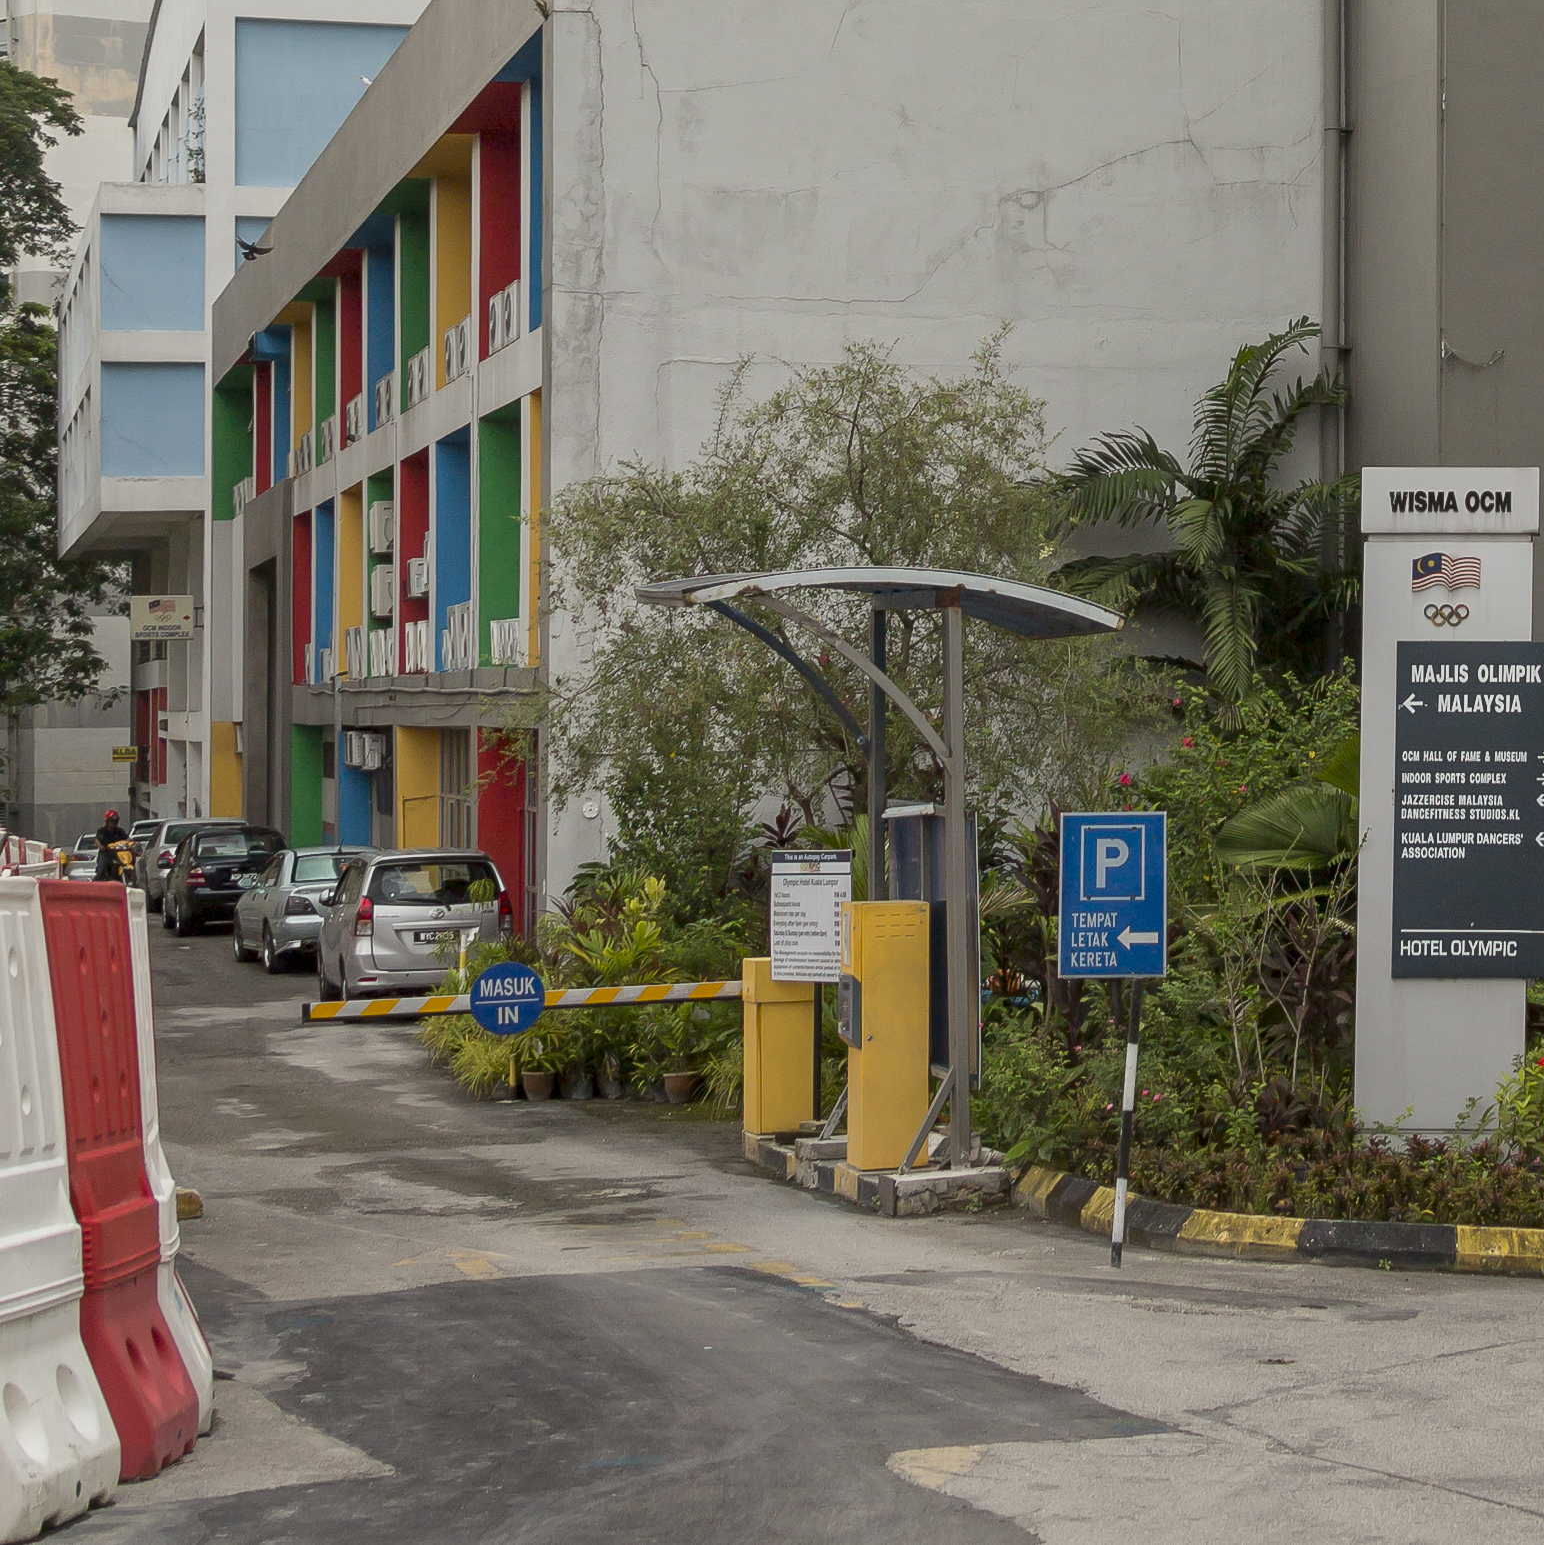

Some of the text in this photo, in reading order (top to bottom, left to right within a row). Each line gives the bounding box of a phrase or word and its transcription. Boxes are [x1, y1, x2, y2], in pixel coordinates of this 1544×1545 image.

[1389, 490, 1512, 513] WISMA OCM
[1411, 664, 1542, 684] MAJLIS OLIMPIK
[1437, 694, 1522, 713] MALAYSIA
[1402, 750, 1528, 762] OCM HALL OF FAME & MUSEUM
[1401, 772, 1507, 784] INDOOR SPORTS COMPLEX
[1401, 794, 1503, 806] JAZZERCISE MALAYSIA
[1401, 808, 1521, 820] DANCEFITNESS STUDIOS.KL
[1401, 832, 1524, 845] KUALA LUMPUR DANCERS'
[1401, 846, 1466, 859] ASSOCIATION
[1096, 838, 1130, 889] P
[1071, 912, 1118, 928] TEMPAT
[1071, 932, 1109, 947] LETAK
[1400, 939, 1518, 957] HOTEL OLYMPIC
[1070, 951, 1118, 967] KERETA
[480, 976, 536, 998] MASUK
[497, 1005, 519, 1025] IN
